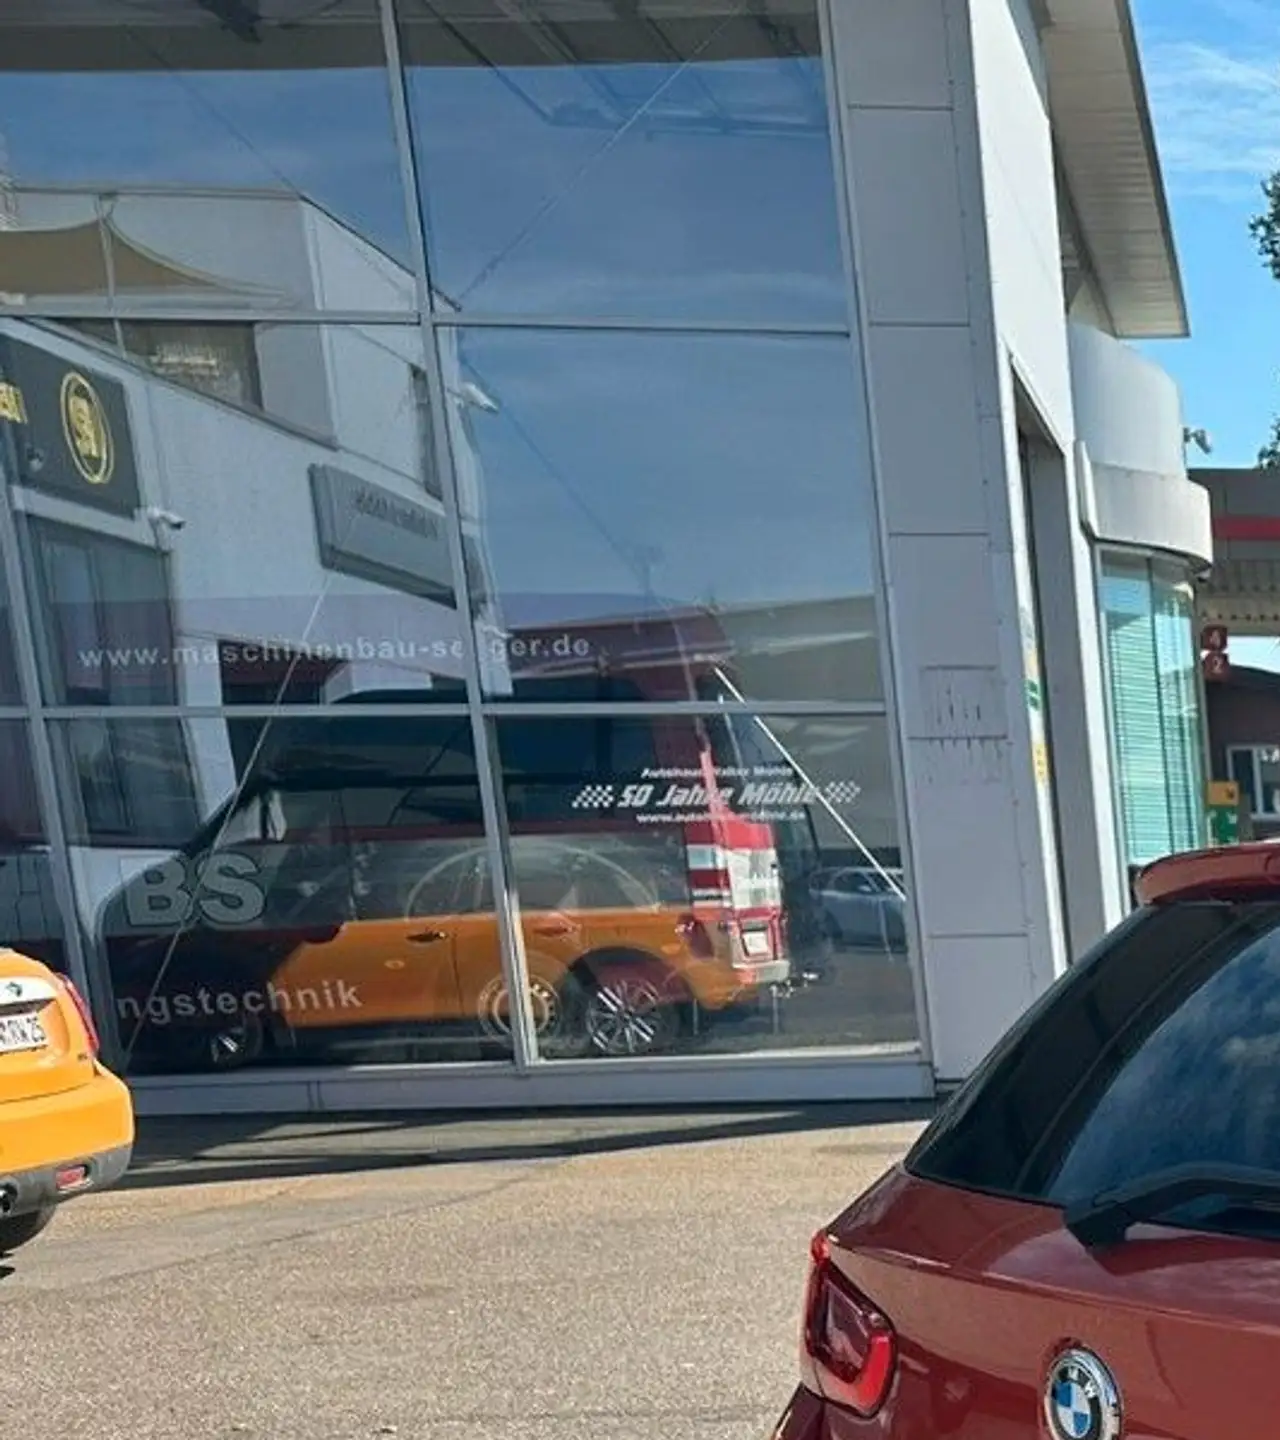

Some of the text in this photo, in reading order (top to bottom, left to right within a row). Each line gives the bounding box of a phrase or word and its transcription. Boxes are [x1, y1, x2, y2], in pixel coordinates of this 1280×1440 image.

[78, 633, 590, 668] www.maschinenbau-seger.de
[616, 783, 655, 809] 50
[119, 852, 265, 927] BS
